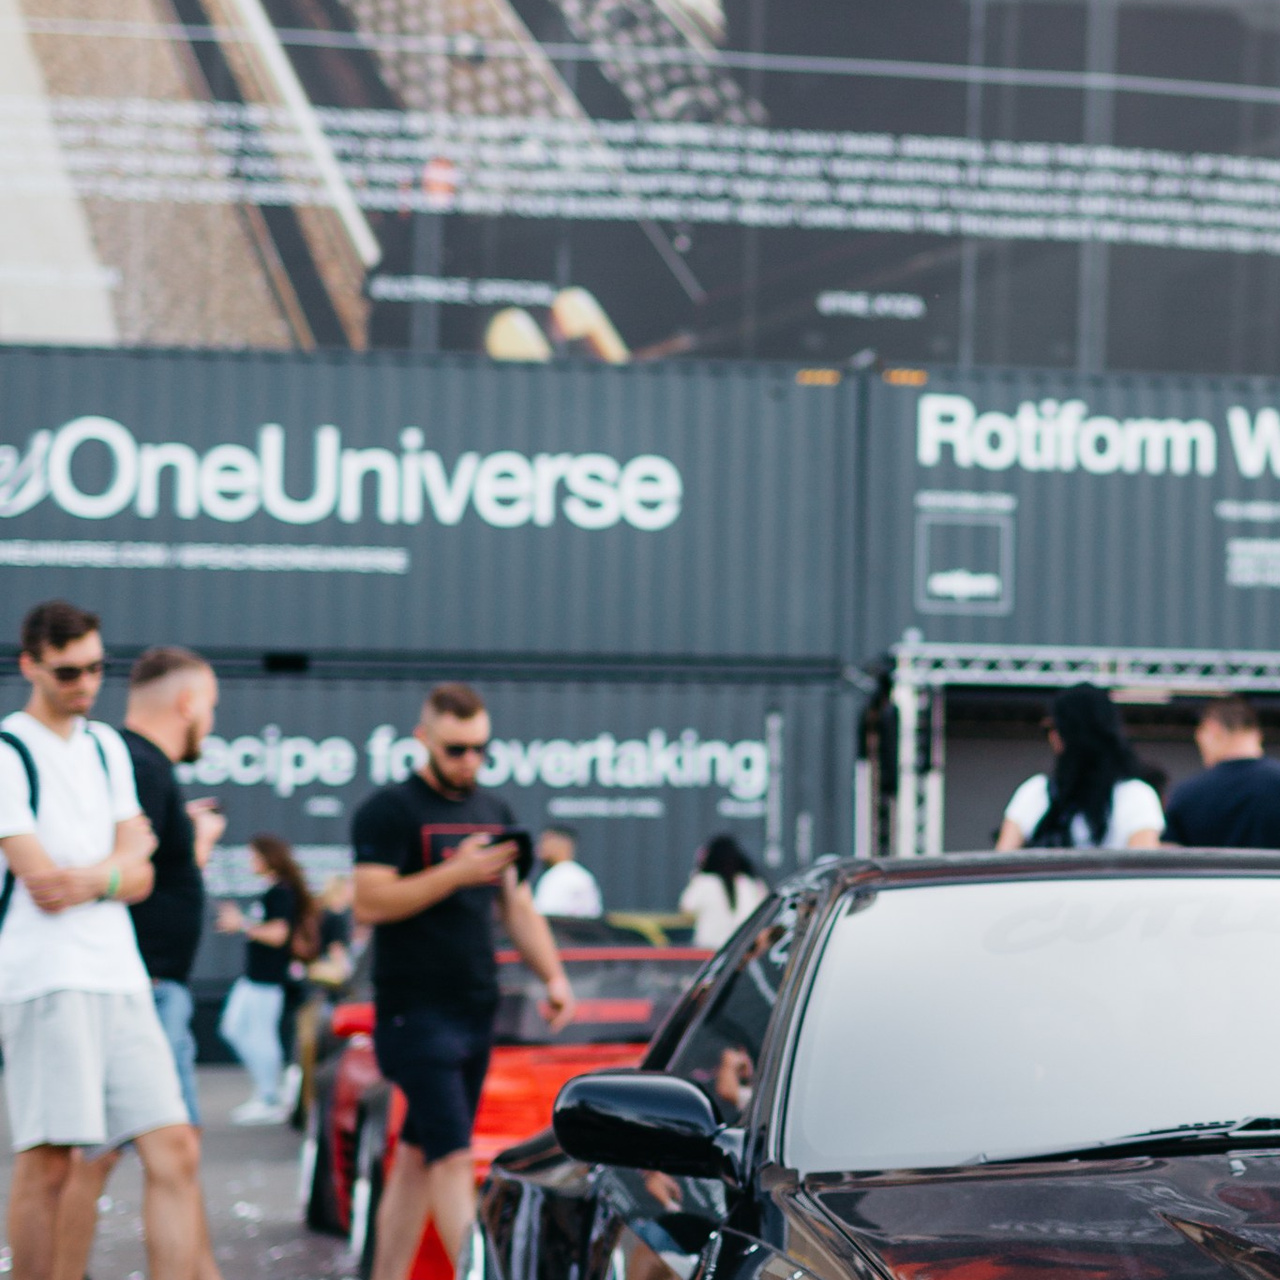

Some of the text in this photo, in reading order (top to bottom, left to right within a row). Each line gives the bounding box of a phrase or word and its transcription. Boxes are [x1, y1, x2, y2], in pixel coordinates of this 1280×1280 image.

[916, 393, 1217, 477] Rotiform
[173, 724, 356, 798] ecipe
[476, 727, 768, 801] overtaking
